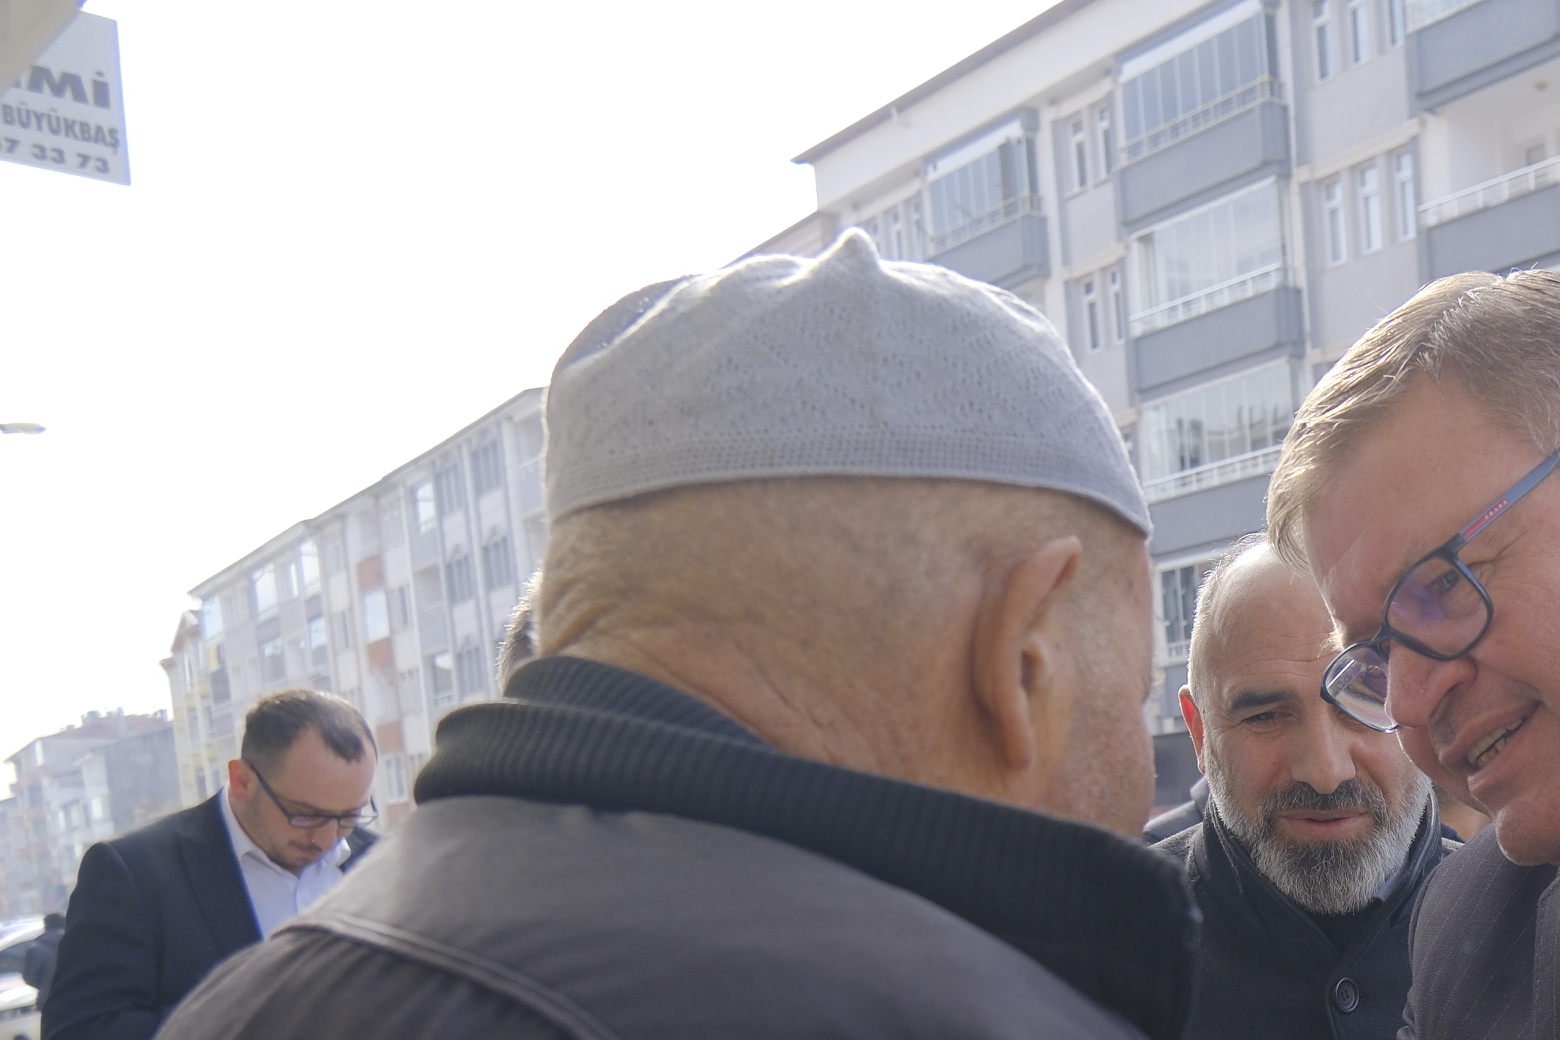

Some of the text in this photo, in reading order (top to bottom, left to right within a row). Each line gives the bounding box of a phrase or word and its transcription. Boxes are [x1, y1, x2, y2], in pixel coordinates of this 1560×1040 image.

[13, 65, 111, 110] Mİ
[2, 101, 120, 155] BÜYÜKBAŞ
[0, 136, 110, 175] 7 33 73
